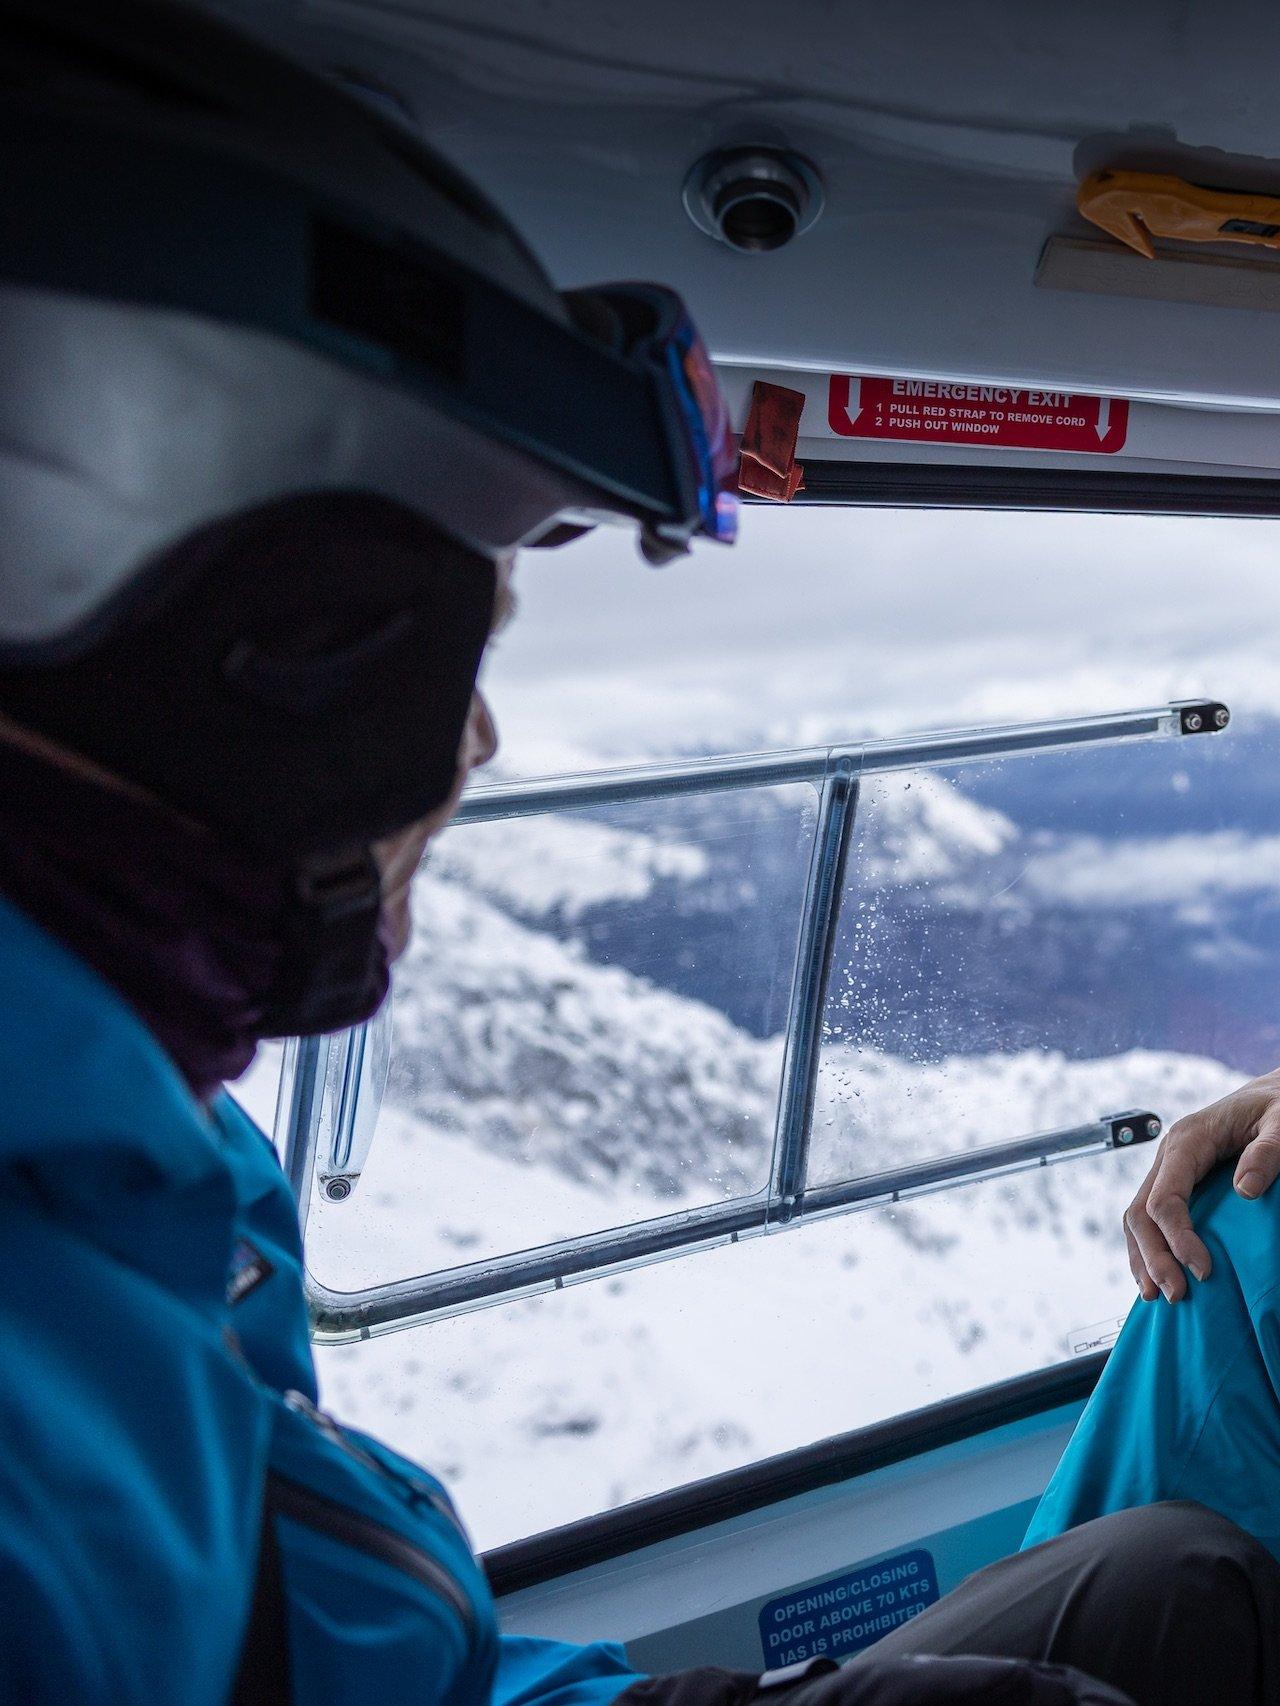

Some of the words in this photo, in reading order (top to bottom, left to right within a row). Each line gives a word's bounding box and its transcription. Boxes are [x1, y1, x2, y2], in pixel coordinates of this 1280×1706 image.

[892, 379, 1021, 405] EMERGENCY
[1027, 390, 1074, 408] EXIT
[875, 416, 883, 427] 2
[889, 417, 921, 429] PUSH
[924, 419, 949, 431] OUT
[951, 421, 1000, 434] WINDOW
[876, 402, 883, 413] 1
[889, 403, 920, 415] PULL
[922, 406, 946, 417] RED
[948, 407, 986, 420] STRAP
[989, 410, 1005, 421] TO
[1007, 412, 1053, 425] REMOVE
[1055, 415, 1086, 427] CORD
[768, 1620, 816, 1648] DOOR
[819, 1599, 873, 1630] ABOVE
[876, 1591, 896, 1609] 70
[899, 1578, 930, 1601] KTS
[780, 1645, 808, 1666] IAS
[811, 1637, 828, 1654] IS
[831, 1602, 926, 1647] PROHIBITED
